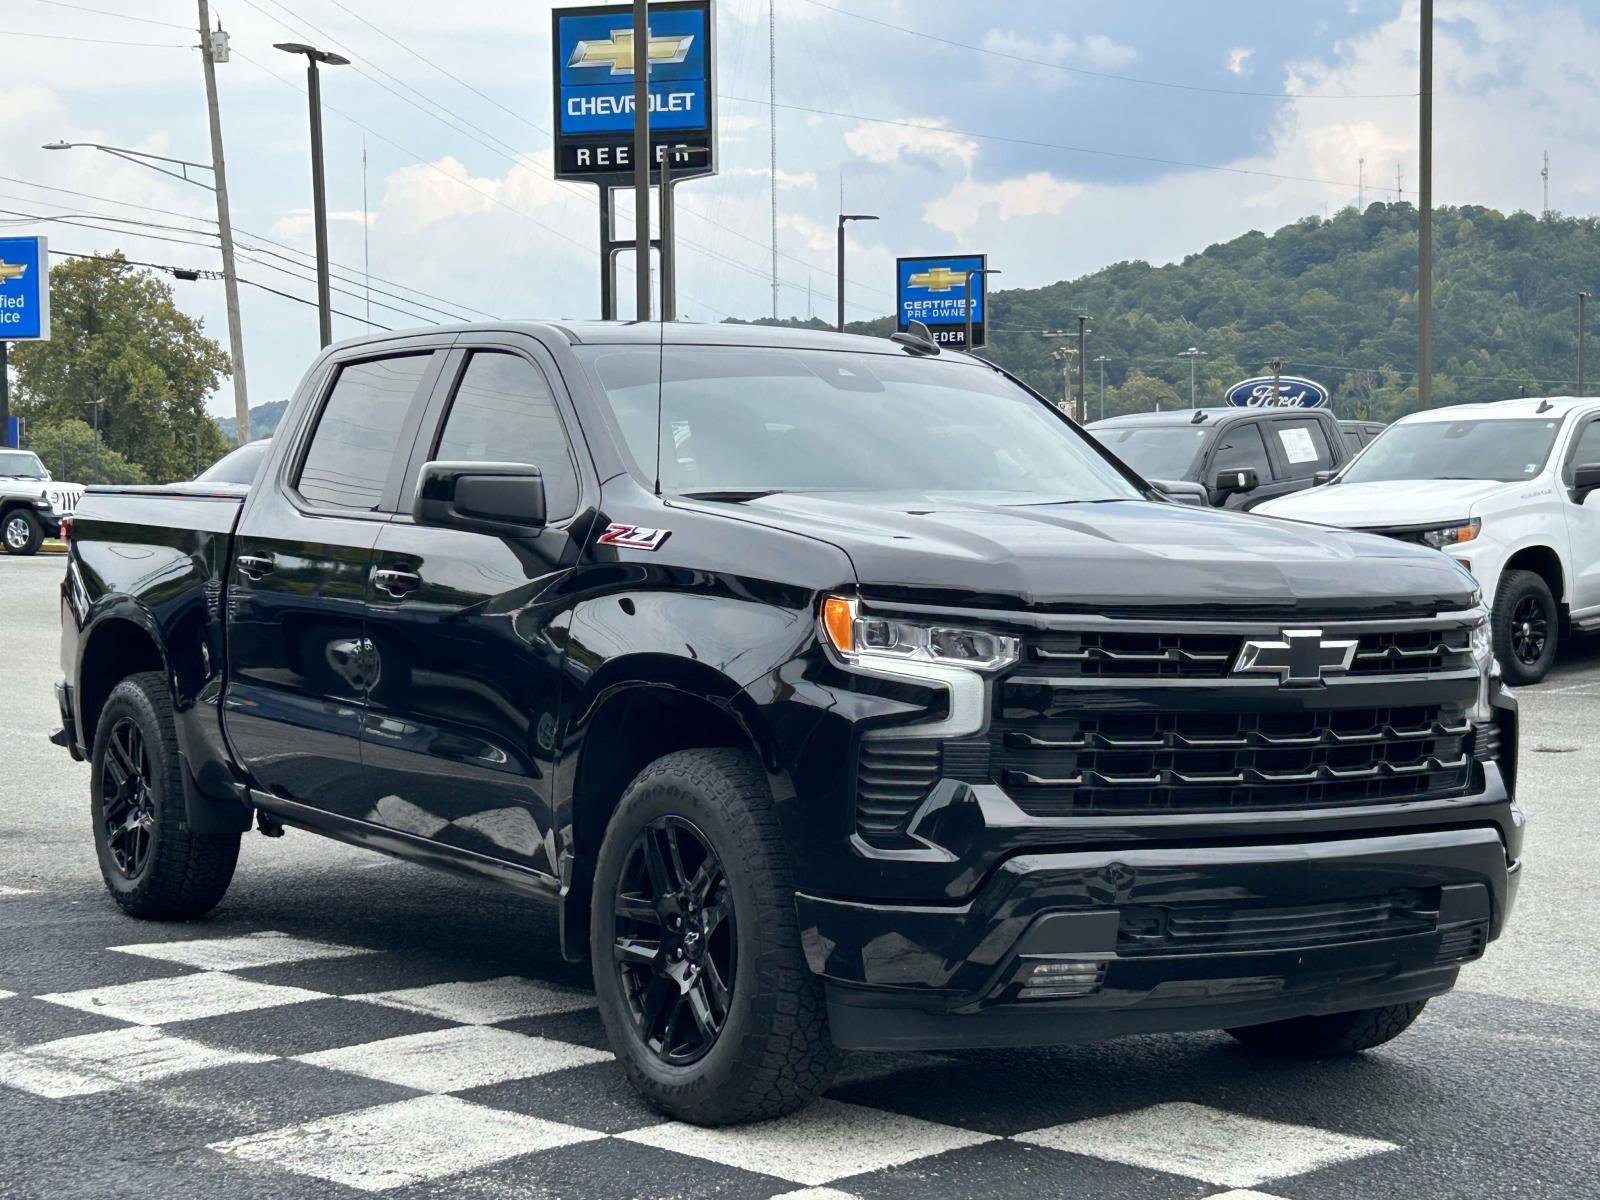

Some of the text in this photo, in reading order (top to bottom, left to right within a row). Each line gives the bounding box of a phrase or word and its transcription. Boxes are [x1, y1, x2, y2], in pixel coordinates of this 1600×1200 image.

[576, 144, 690, 166] REEER
[0, 294, 24, 308] fied
[0, 310, 21, 324] ice
[932, 331, 965, 342] EDER
